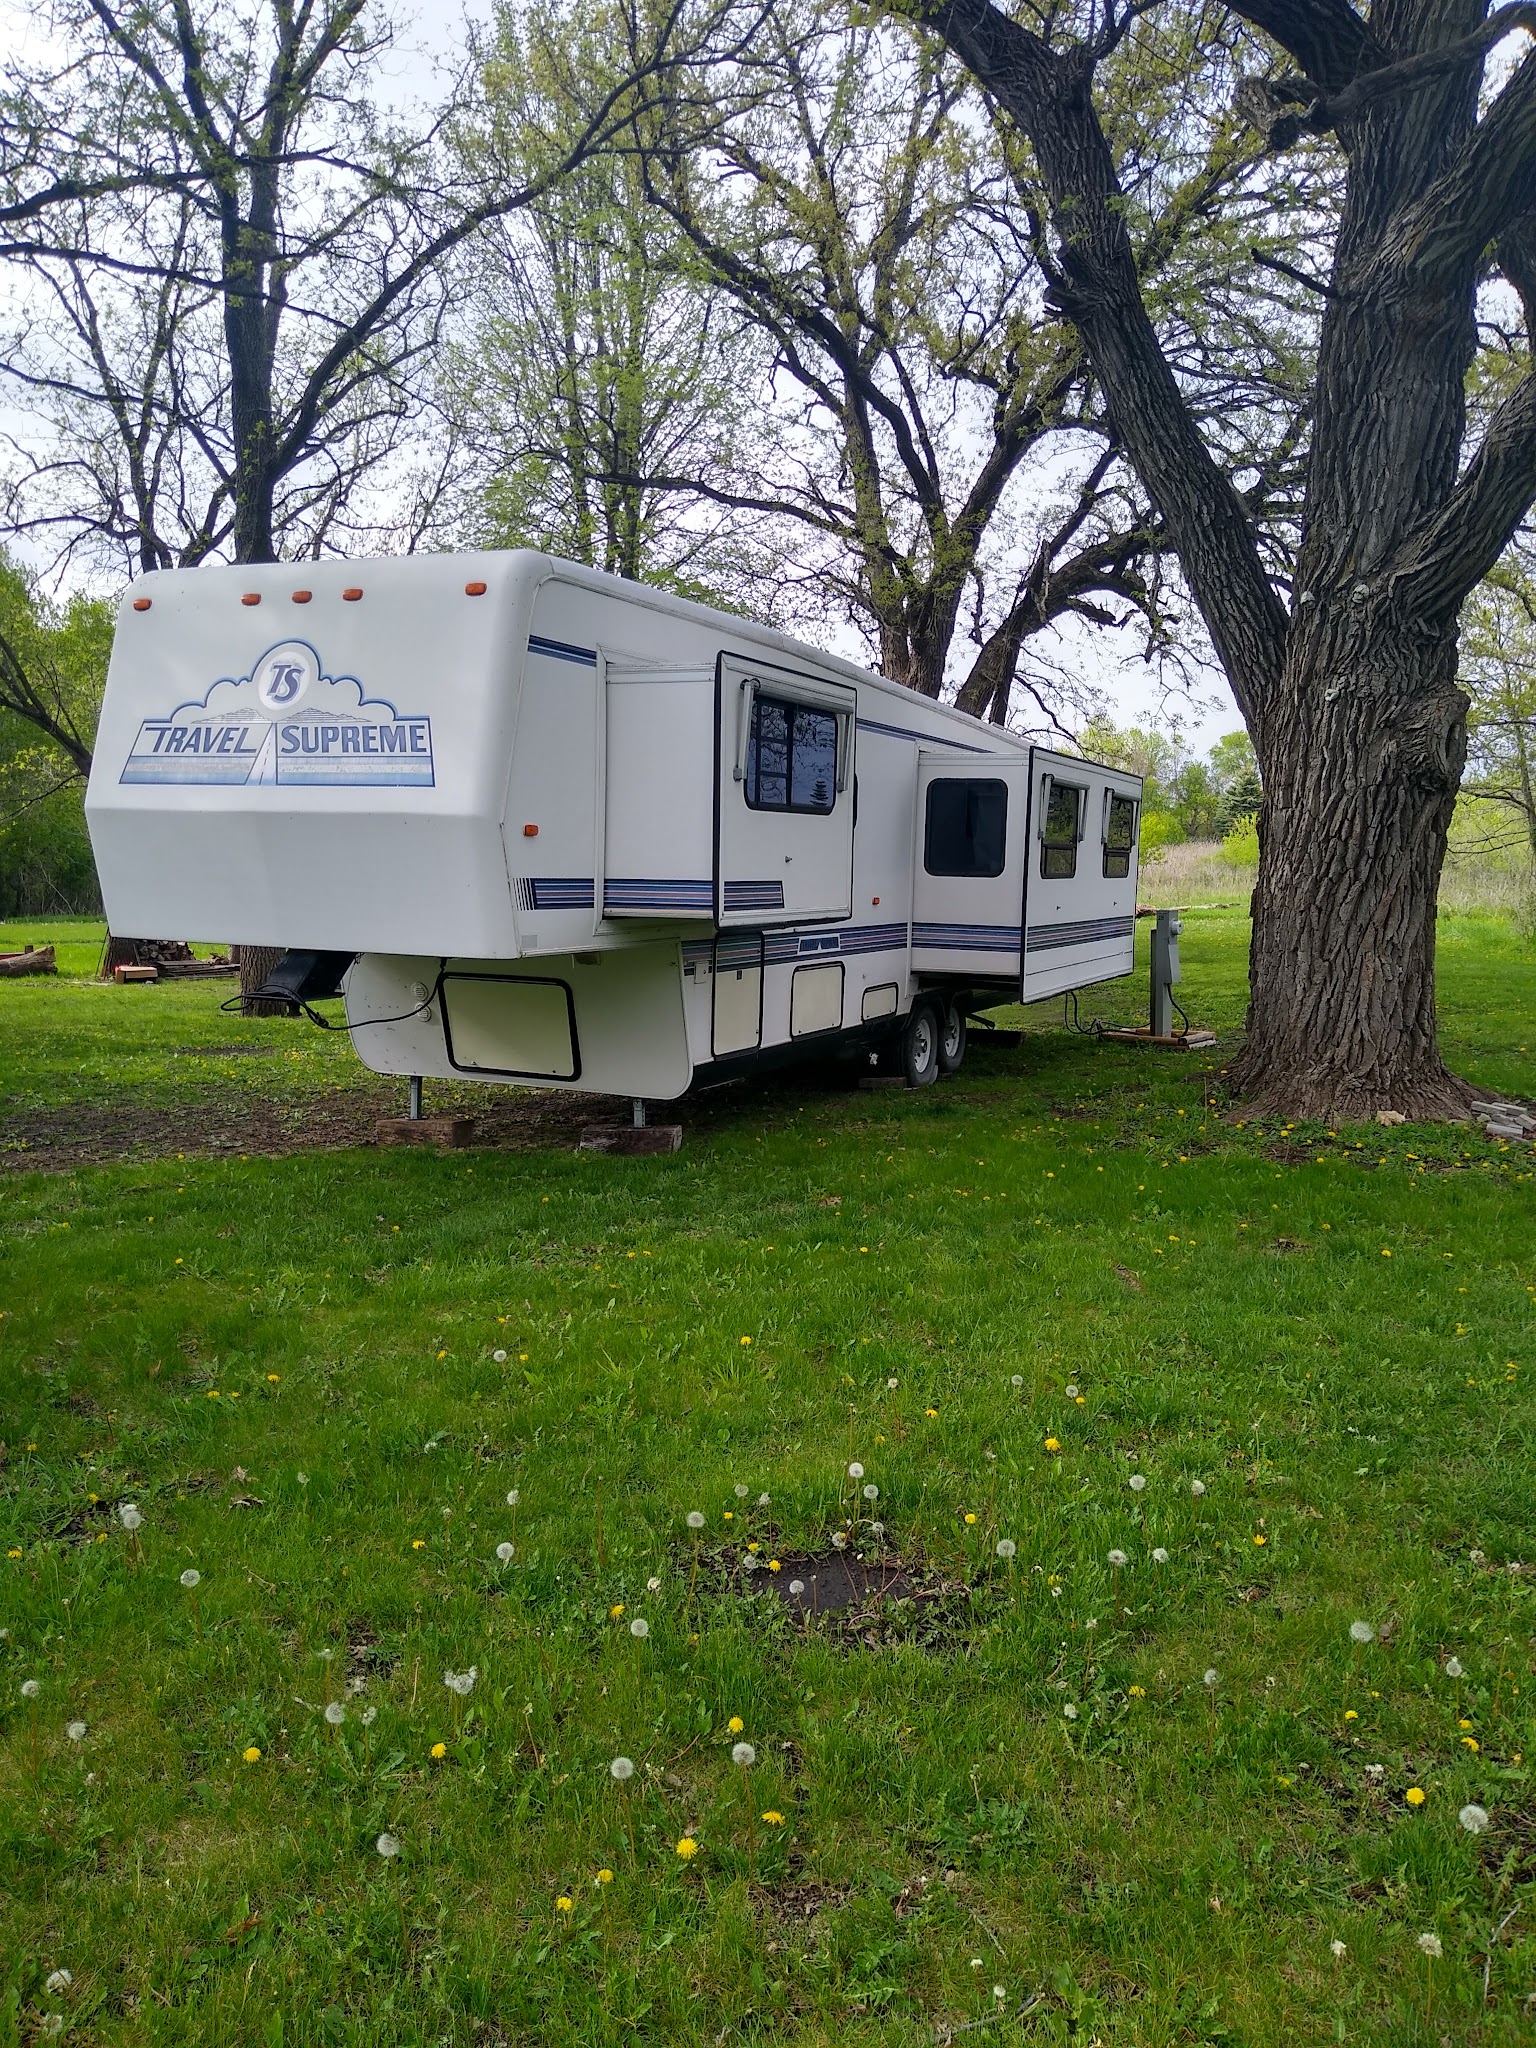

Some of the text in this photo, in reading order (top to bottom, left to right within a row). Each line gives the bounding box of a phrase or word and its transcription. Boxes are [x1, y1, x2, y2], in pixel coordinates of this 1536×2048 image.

[269, 663, 303, 702] TS
[145, 725, 427, 753] TRAVEL SUPREME
